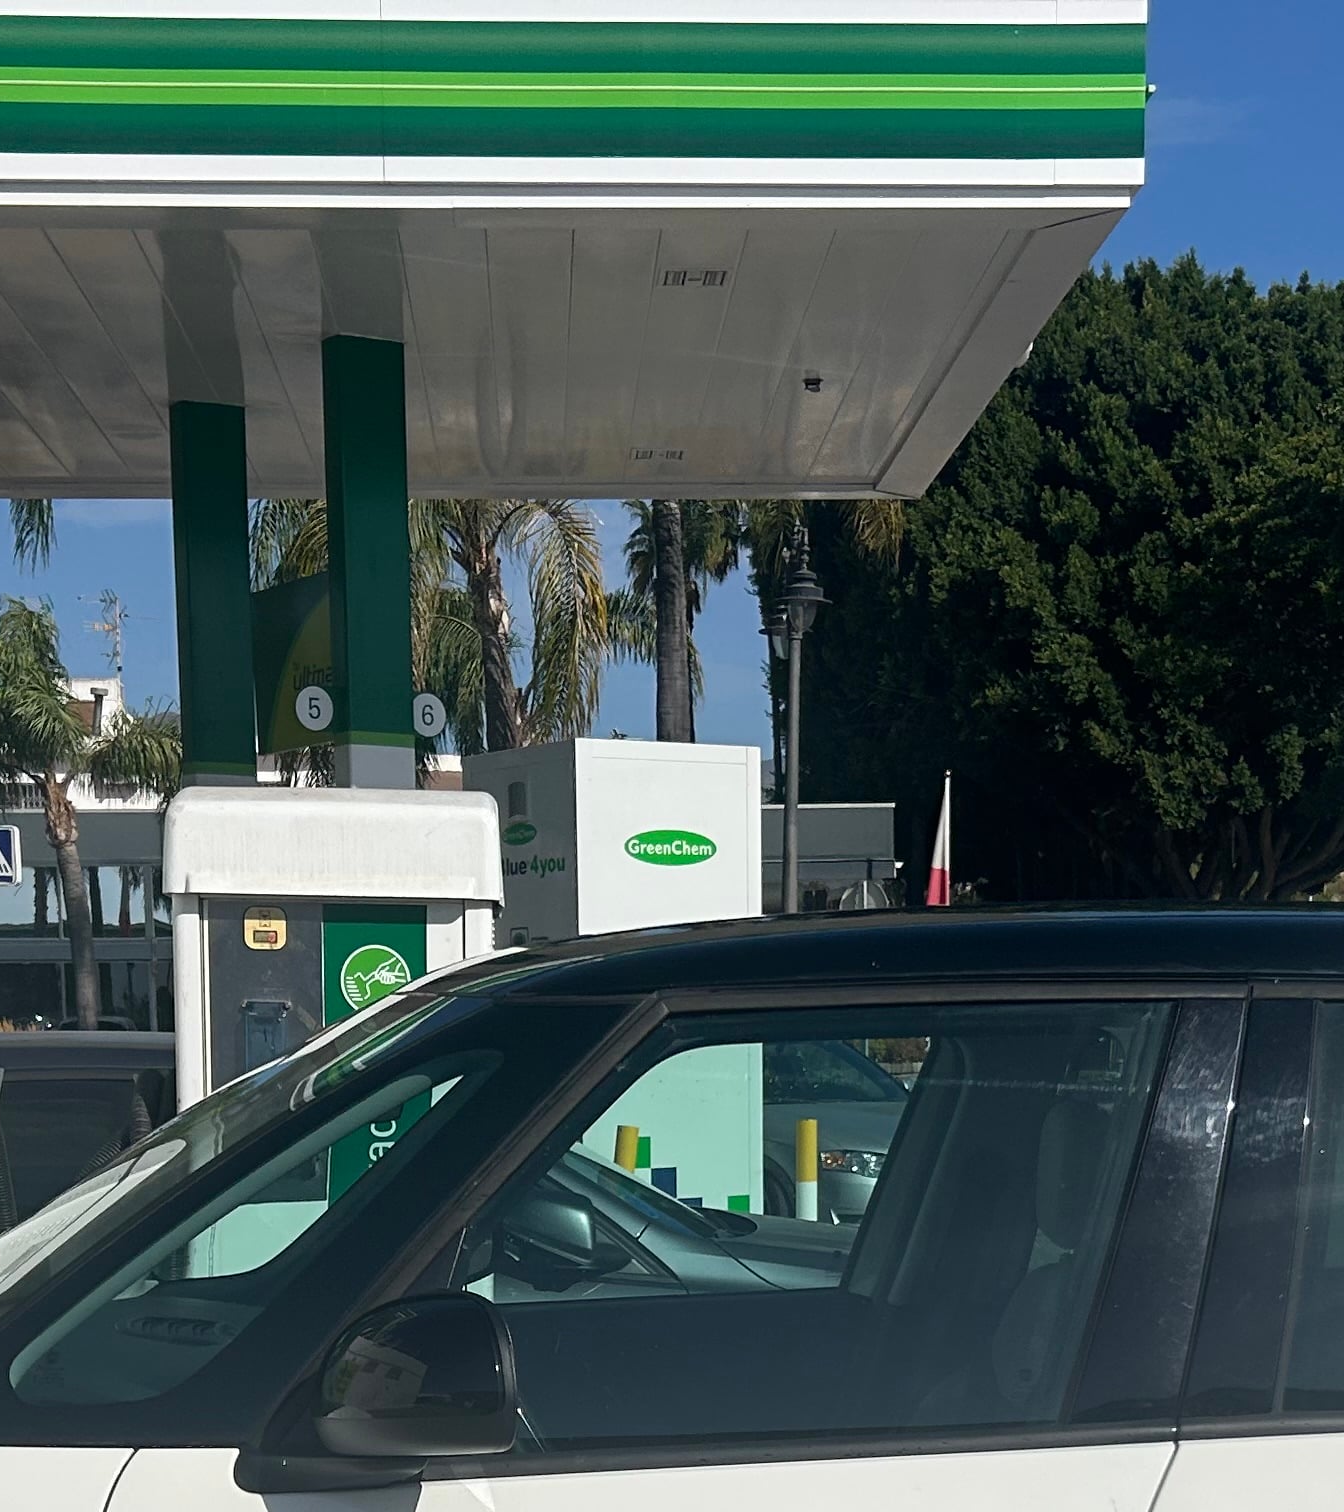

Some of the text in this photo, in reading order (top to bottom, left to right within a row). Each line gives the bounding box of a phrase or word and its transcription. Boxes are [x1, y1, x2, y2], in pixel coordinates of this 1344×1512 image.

[308, 697, 321, 719] 5
[421, 704, 434, 726] 6
[628, 839, 712, 856] GreenChem
[530, 854, 566, 879] 4you
